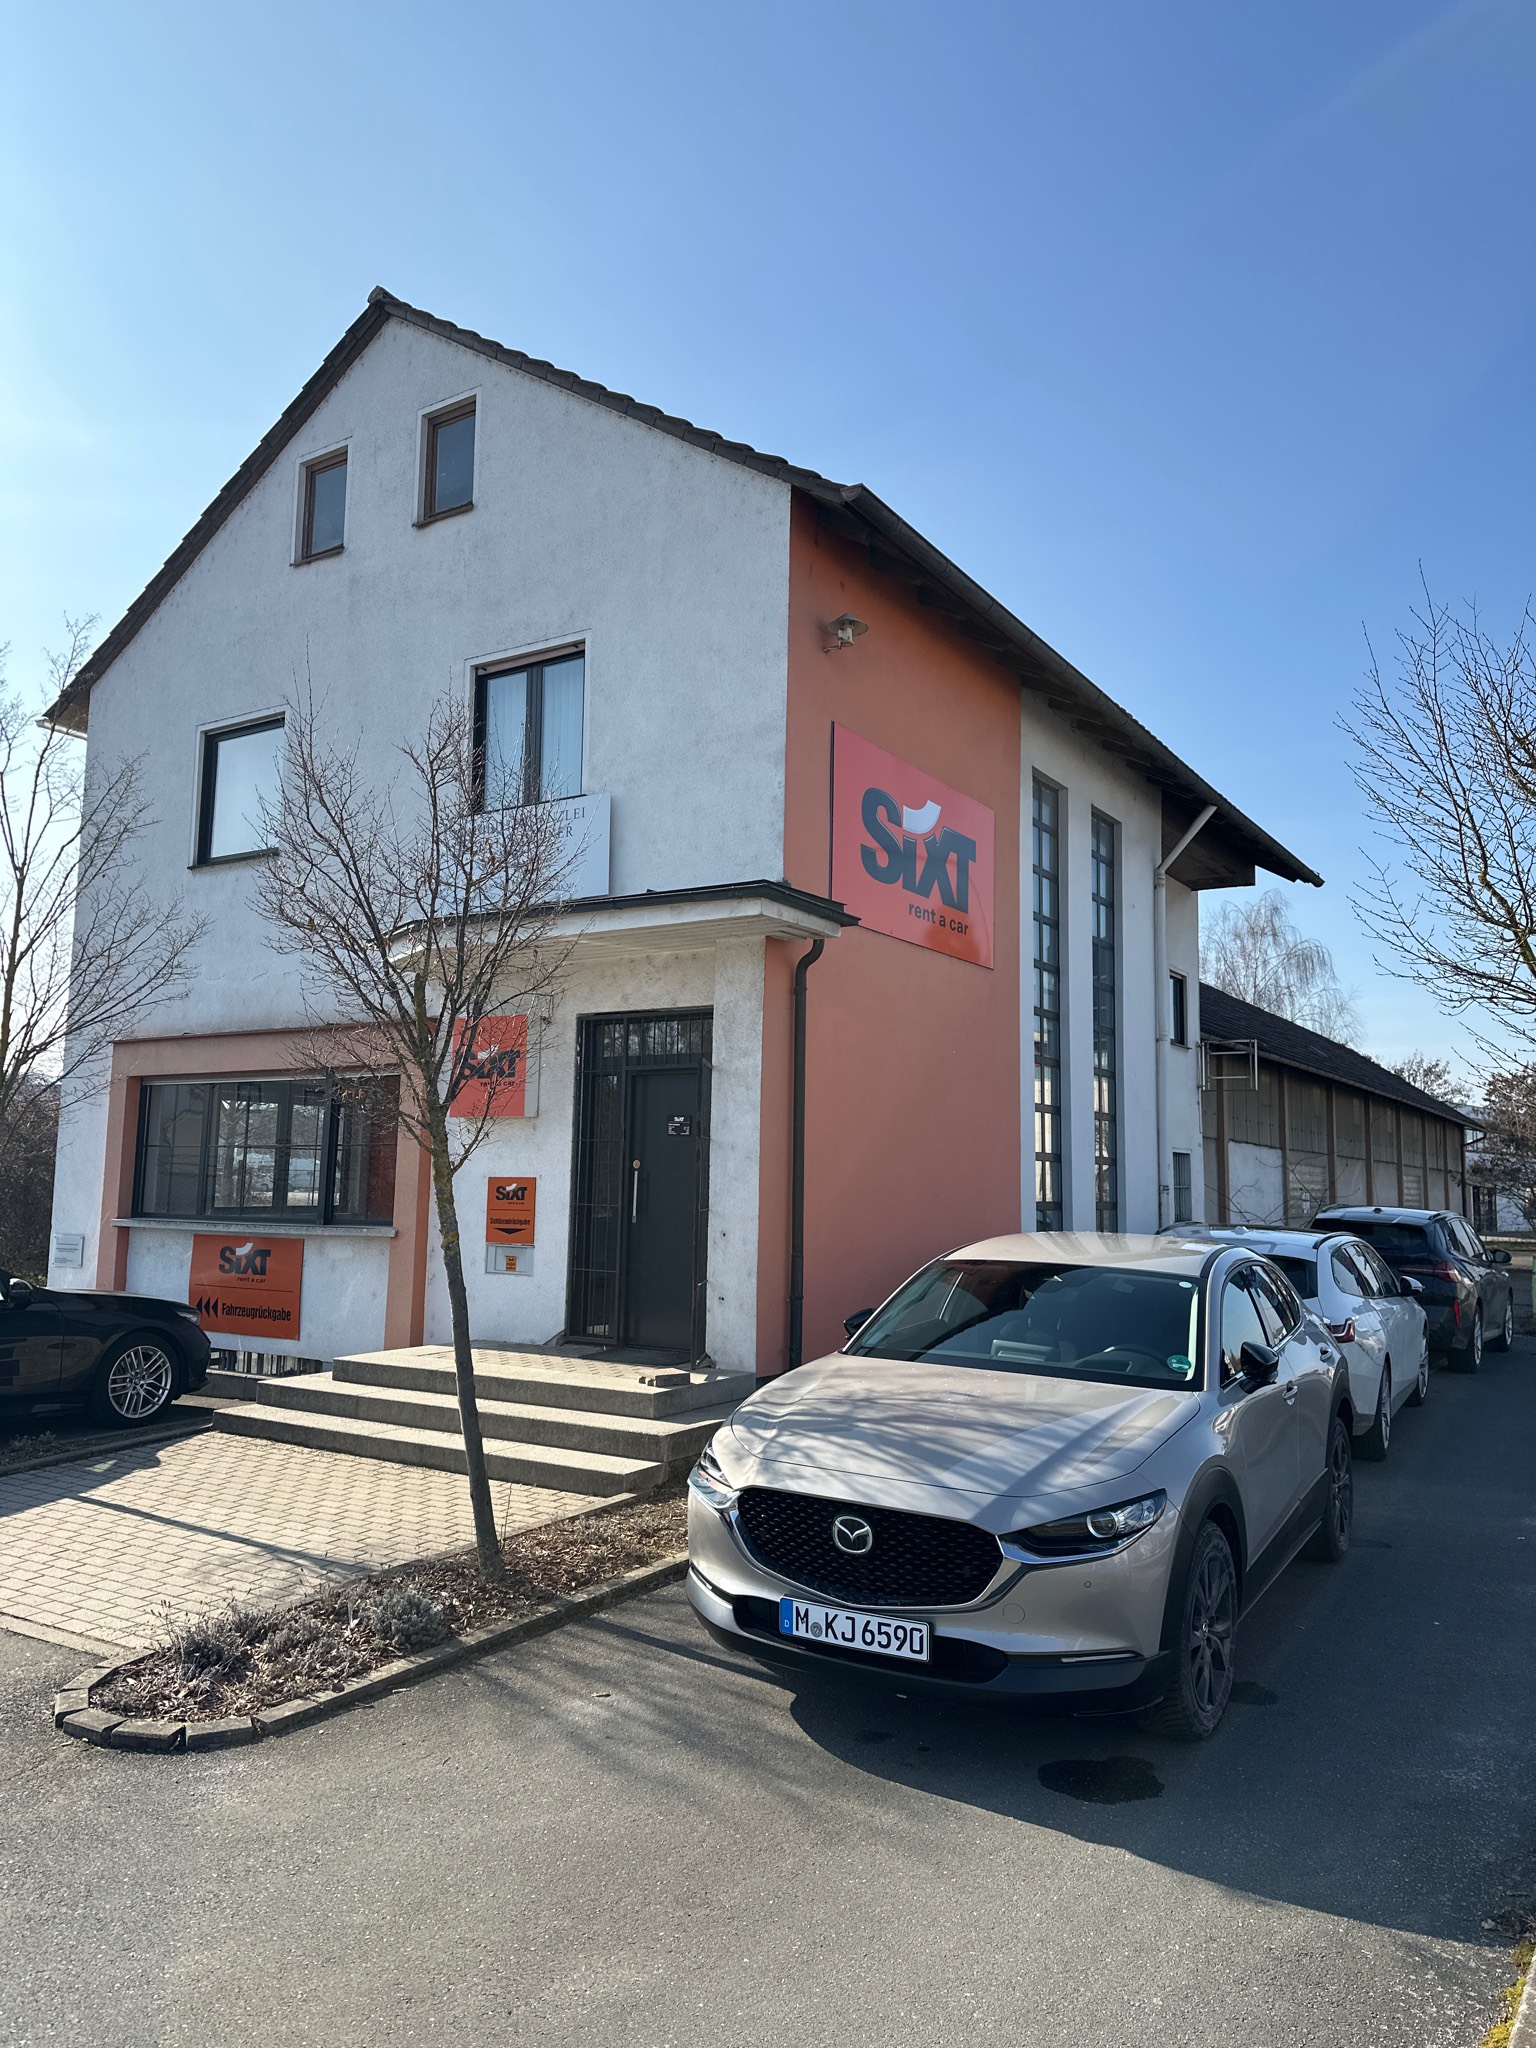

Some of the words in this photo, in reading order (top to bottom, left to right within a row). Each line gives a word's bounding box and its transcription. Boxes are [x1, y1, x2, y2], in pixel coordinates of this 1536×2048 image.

[909, 903, 936, 924] rent
[939, 914, 946, 928] a
[949, 918, 969, 936] car
[222, 1302, 291, 1322] Fahrzeugrückgabe
[784, 1619, 790, 1628] D
[795, 1605, 810, 1634] M
